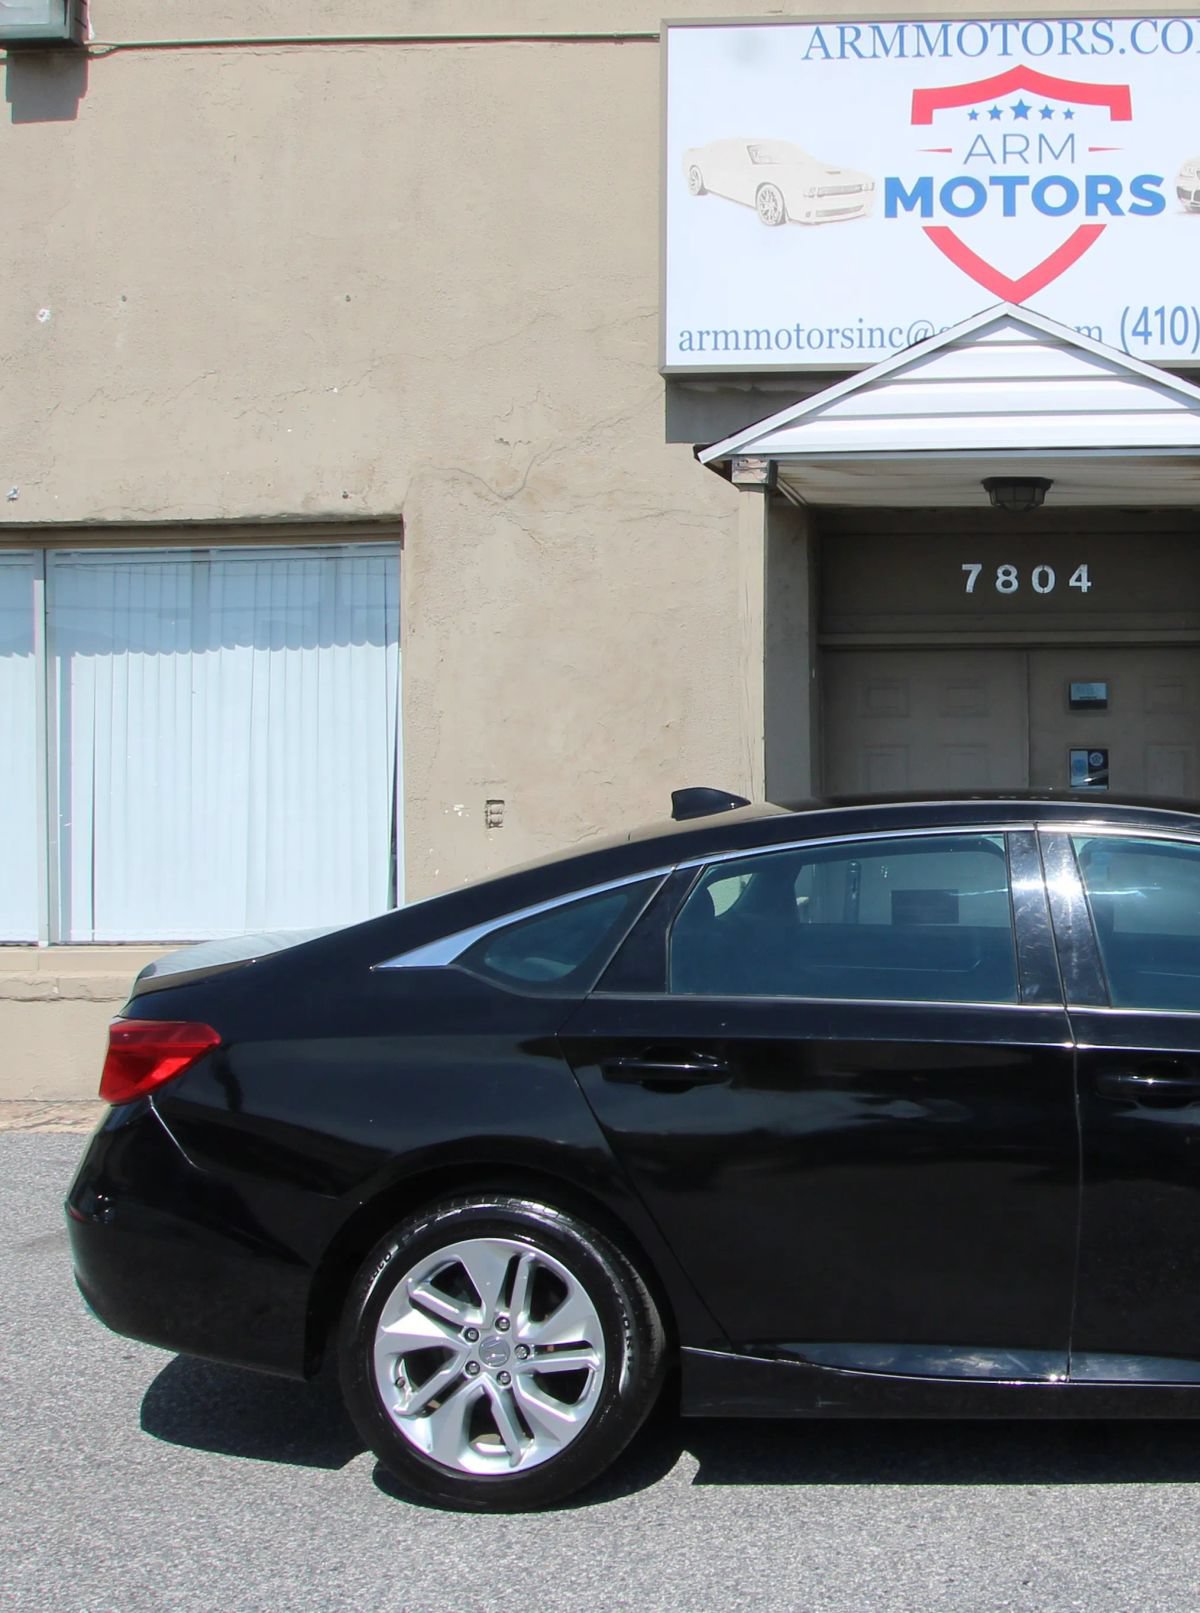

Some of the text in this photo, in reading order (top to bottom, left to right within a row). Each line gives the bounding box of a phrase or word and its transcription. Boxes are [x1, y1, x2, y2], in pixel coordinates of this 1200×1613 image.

[963, 133, 1075, 164] ARM
[884, 174, 1166, 218] MOTORS
[962, 563, 1092, 594] 7804
